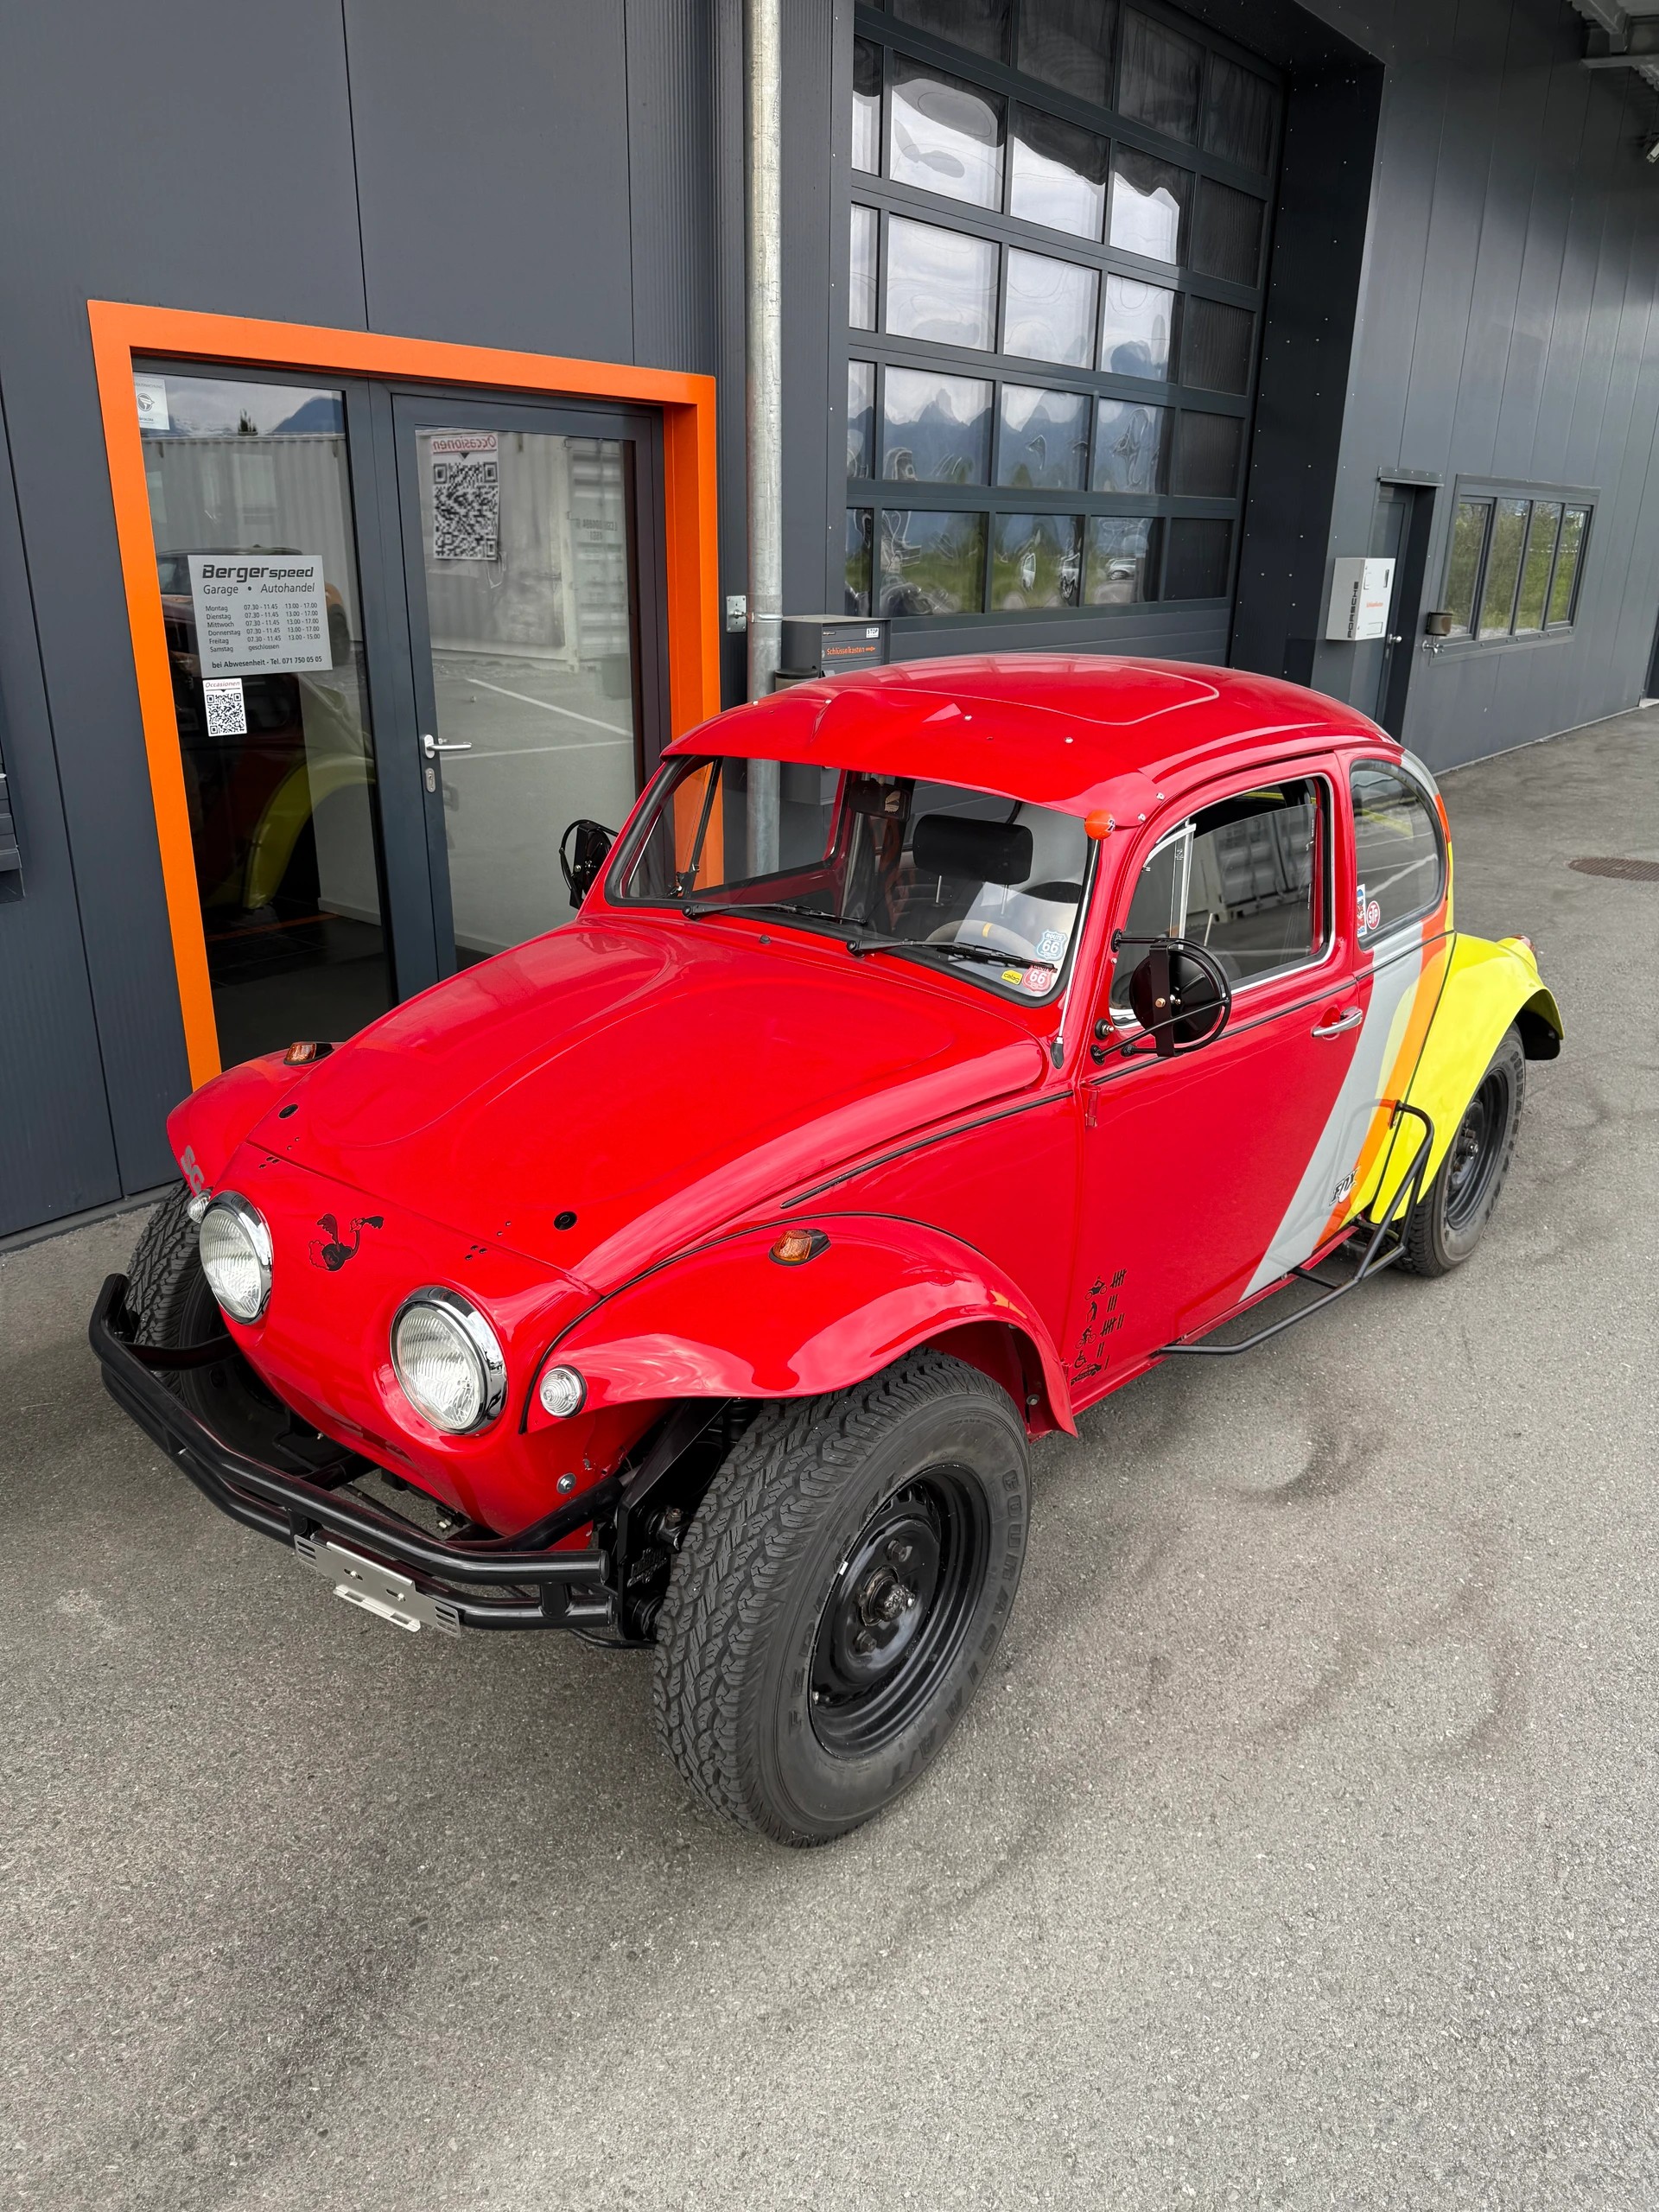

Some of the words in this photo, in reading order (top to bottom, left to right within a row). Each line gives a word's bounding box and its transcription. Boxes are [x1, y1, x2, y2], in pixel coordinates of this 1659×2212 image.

[202, 564, 314, 582] Bergerspeed
[203, 584, 238, 596] Garage
[260, 582, 315, 594] Autohandel
[1347, 581, 1359, 638] PORSCHE
[224, 659, 265, 668] Abwesenheit
[1368, 905, 1378, 924] STP
[1042, 940, 1059, 953] 66
[1030, 969, 1046, 983] 66
